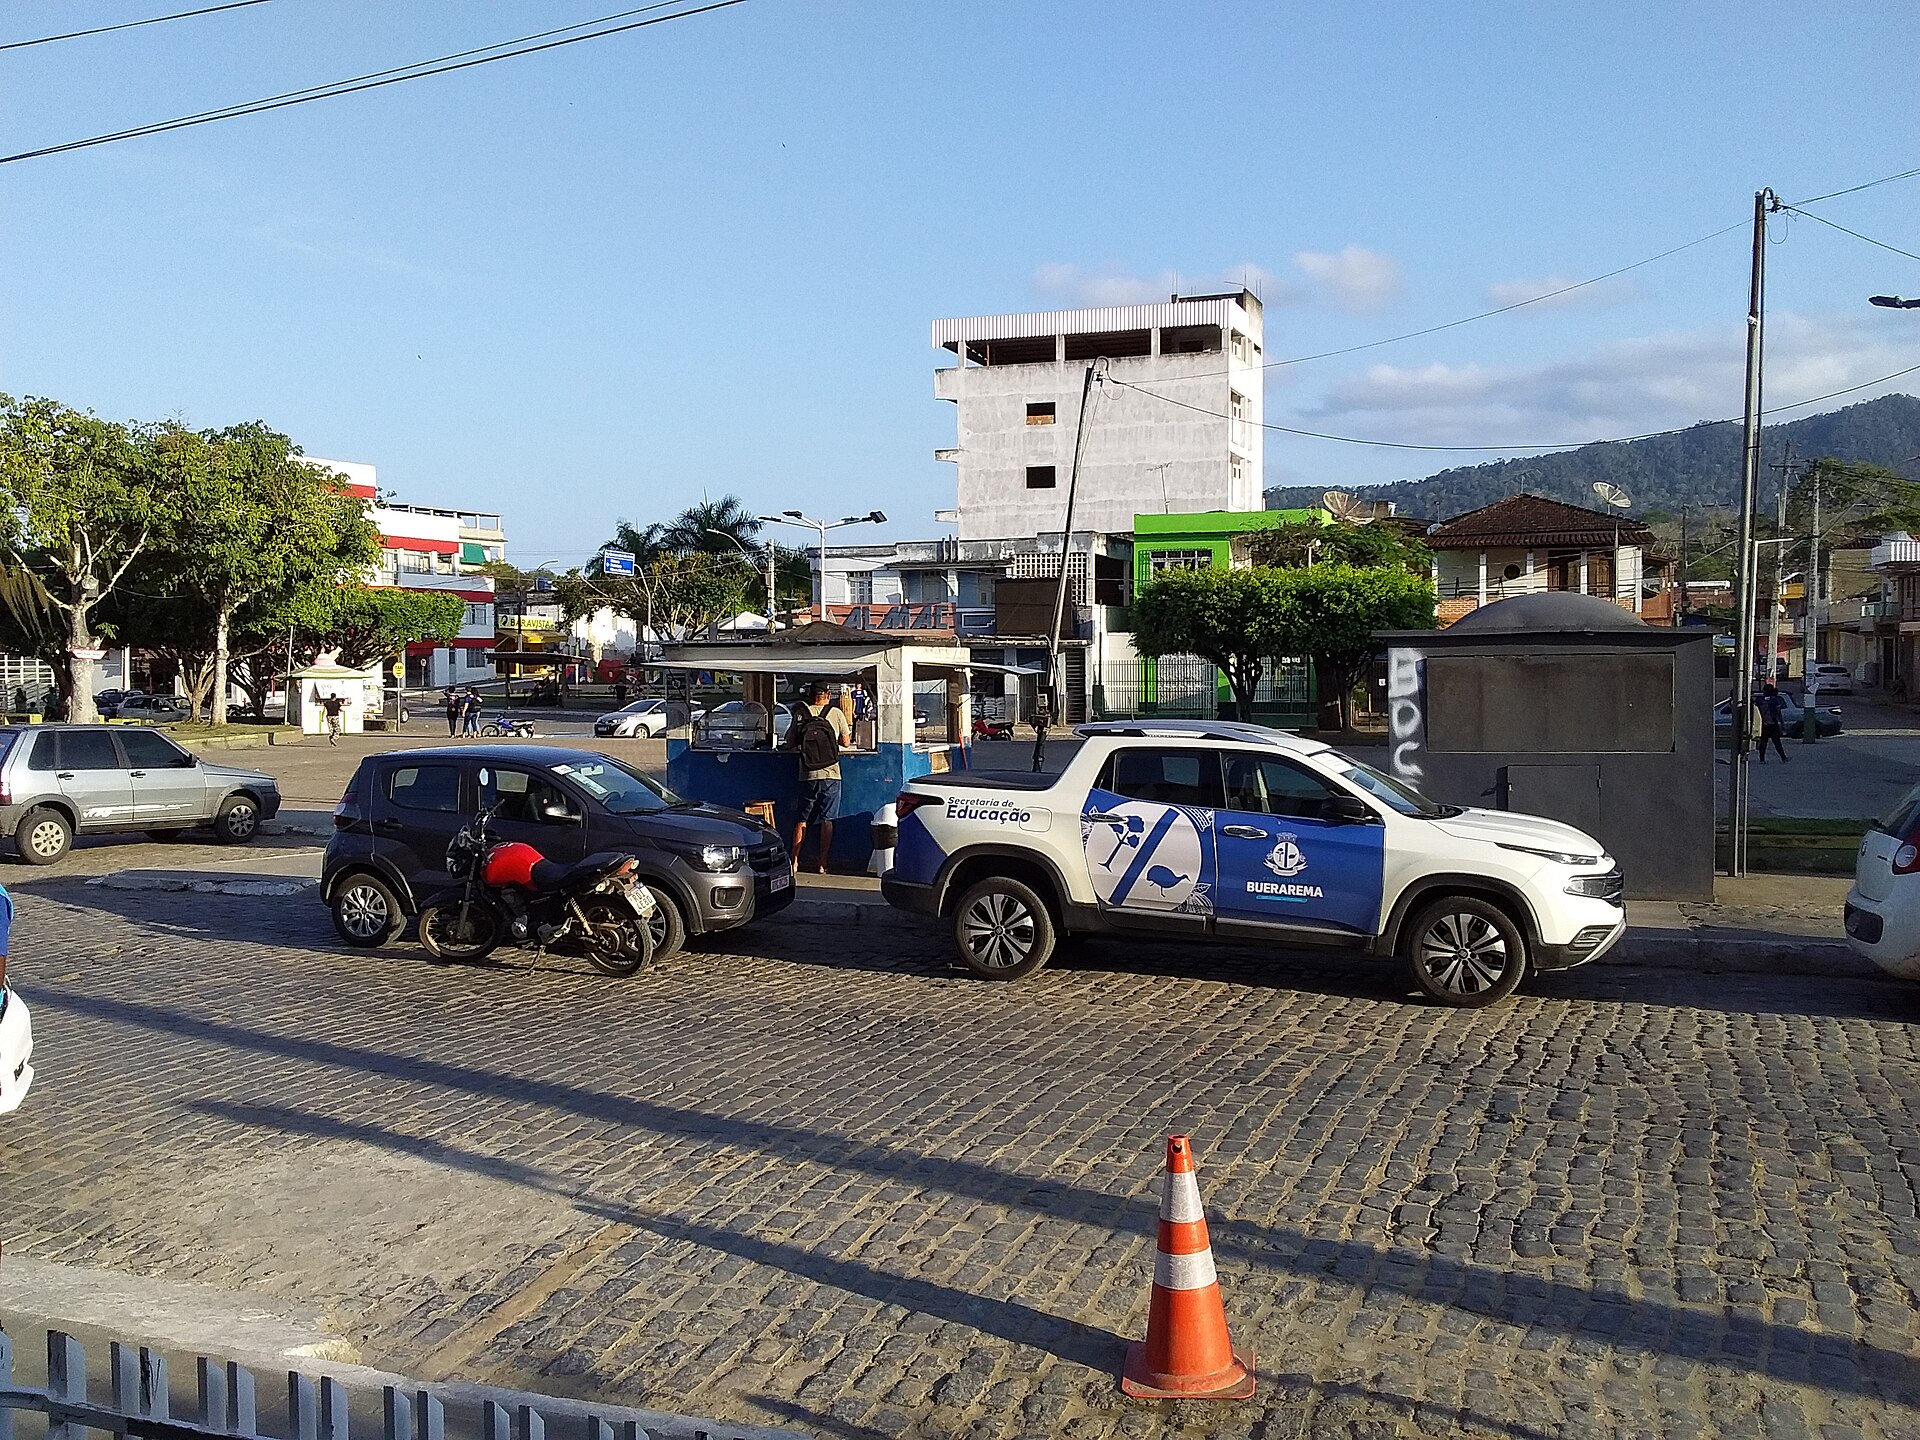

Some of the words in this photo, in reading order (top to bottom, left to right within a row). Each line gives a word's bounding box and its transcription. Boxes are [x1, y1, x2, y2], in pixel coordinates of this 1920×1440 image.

[947, 796, 1000, 807] Secretaria
[1001, 799, 1014, 808] de
[946, 804, 1031, 825] Educação
[1246, 881, 1324, 898] BUERAREMA
